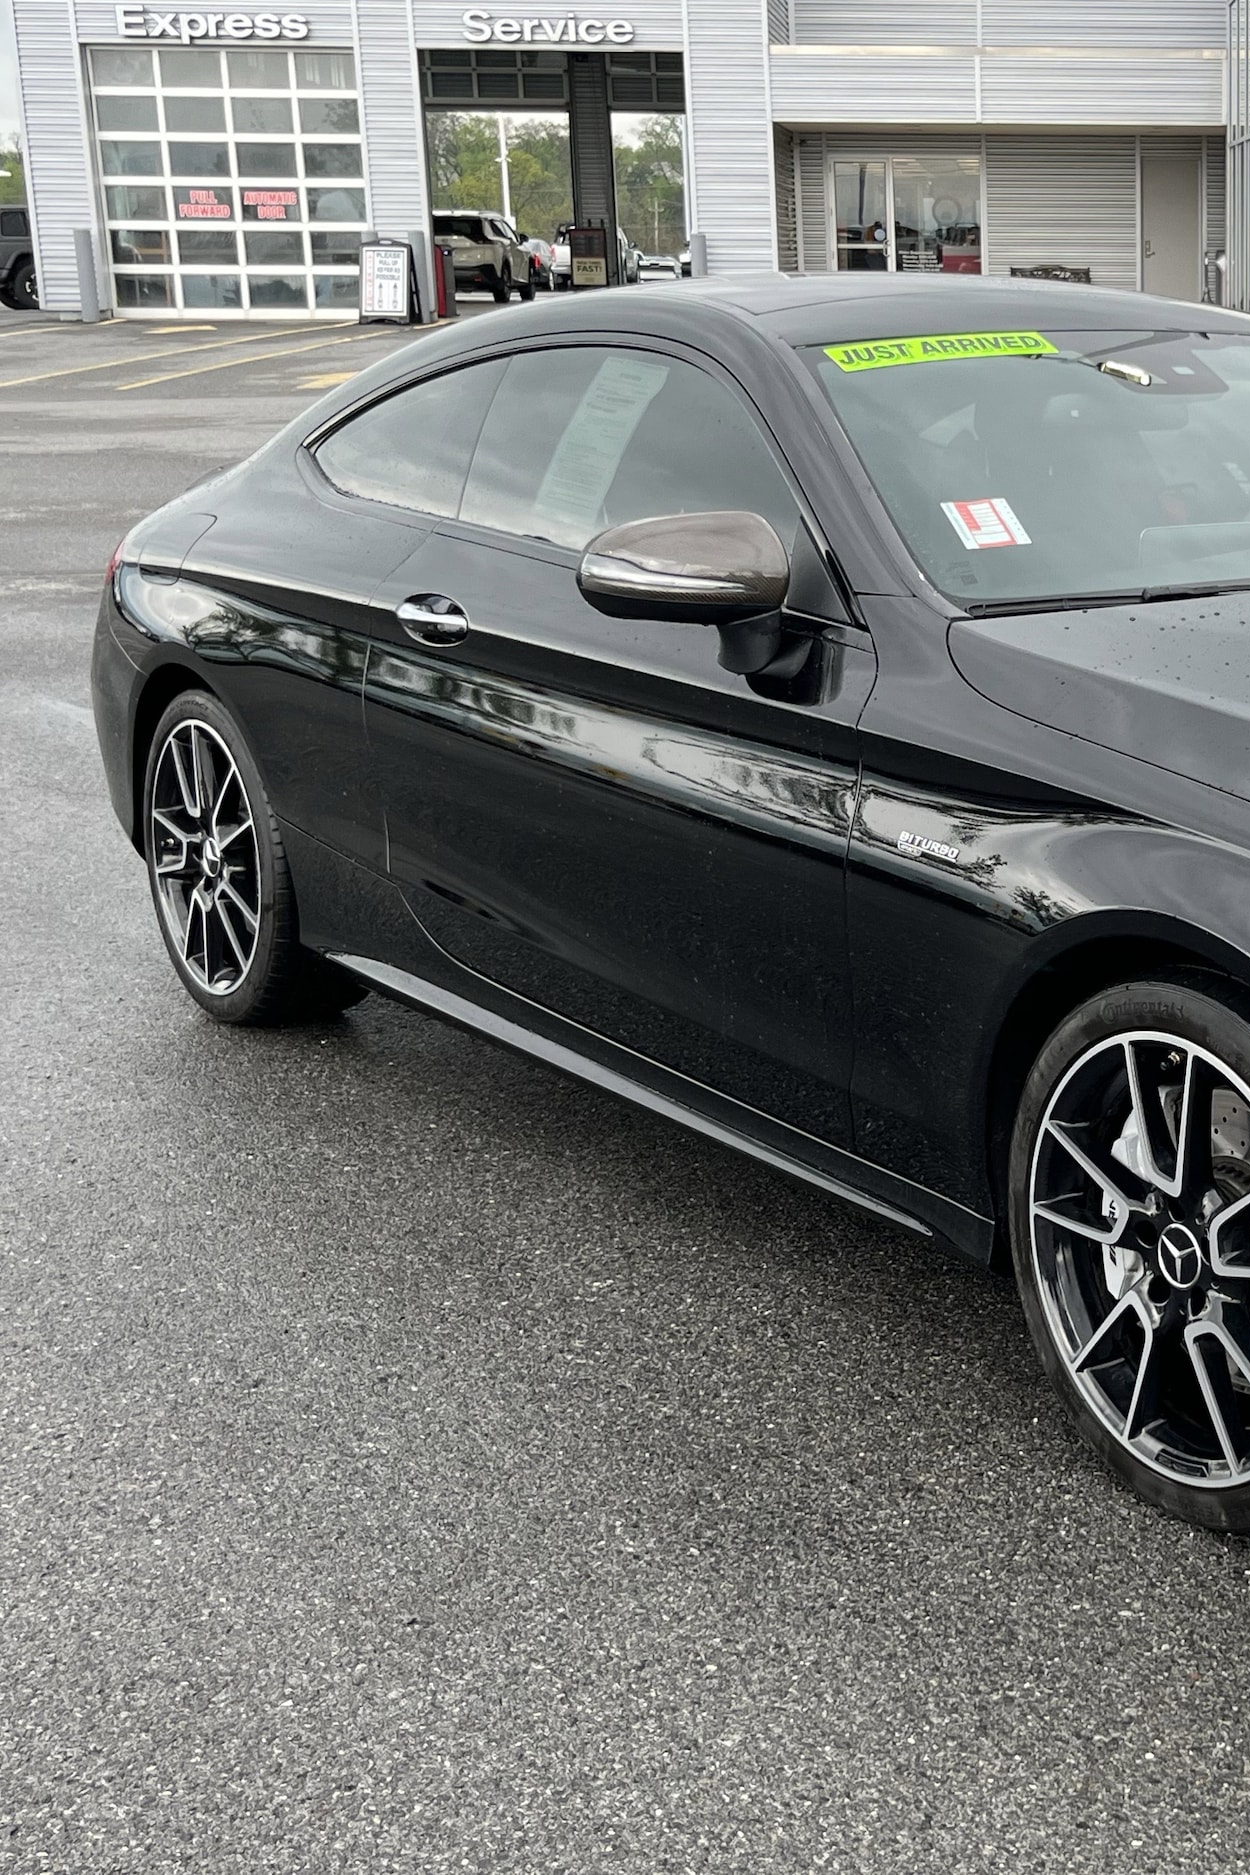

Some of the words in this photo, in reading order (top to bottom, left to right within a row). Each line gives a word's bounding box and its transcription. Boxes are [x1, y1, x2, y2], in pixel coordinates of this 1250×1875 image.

[115, 4, 310, 45] Express
[462, 9, 635, 44] Service
[189, 190, 218, 204] PULL
[243, 191, 298, 205] AUTOMATIC
[178, 204, 231, 218] FORWARD
[257, 206, 287, 219] DOOR
[839, 343, 912, 365] JUST
[920, 335, 1043, 356] ARRIVED
[899, 830, 960, 859] BITURBO
